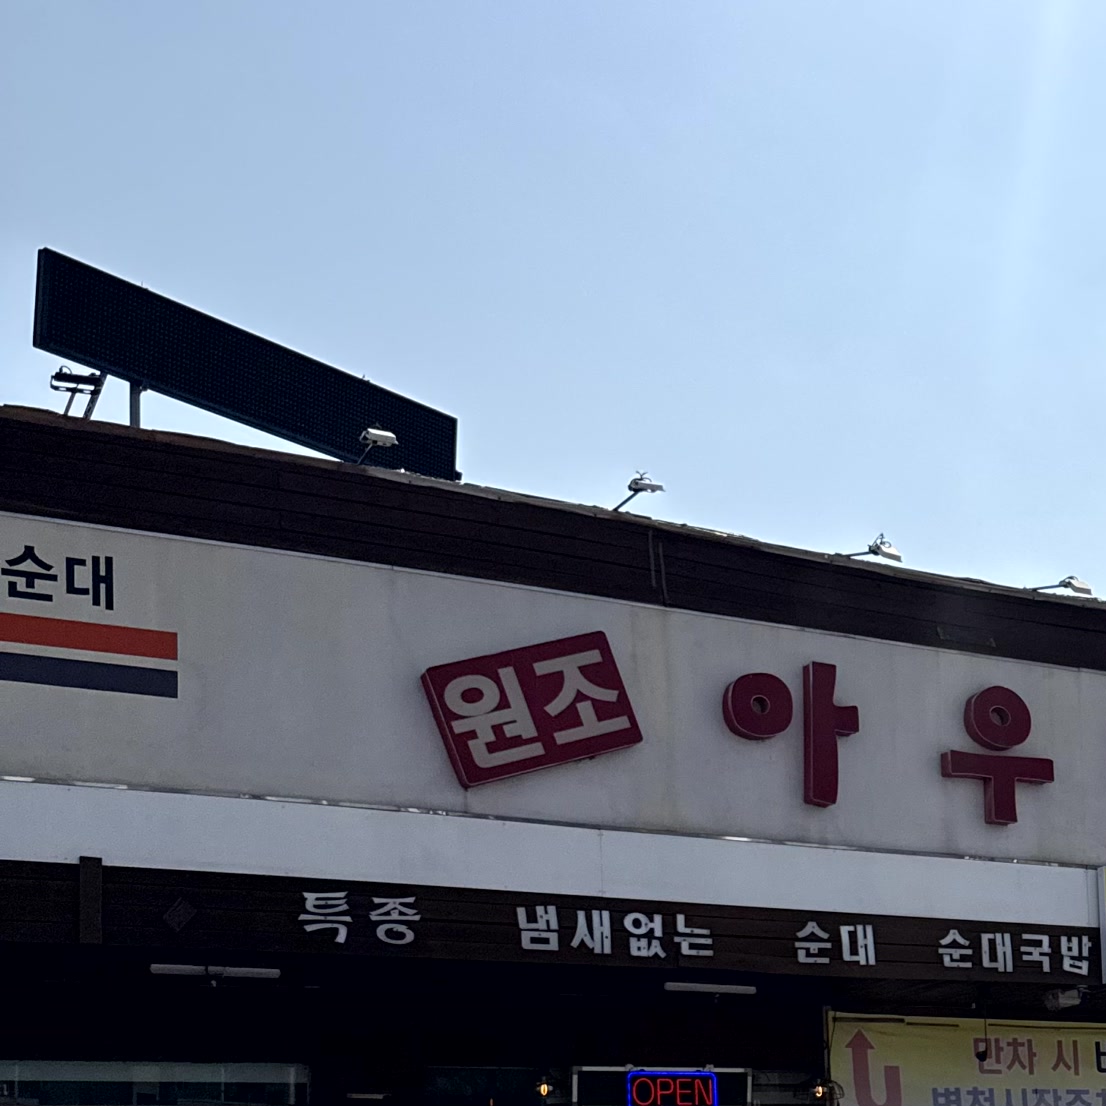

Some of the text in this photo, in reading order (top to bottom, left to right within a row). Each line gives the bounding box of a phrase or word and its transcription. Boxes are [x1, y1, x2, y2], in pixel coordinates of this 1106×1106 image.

[2, 546, 114, 609] 순대
[442, 650, 631, 769] 원조
[298, 891, 1092, 976] 특종 냄새없는 순대 순대국밥
[972, 1036, 1036, 1075] 만차
[1051, 1038, 1080, 1077] 시
[632, 1077, 713, 1106] OPEN
